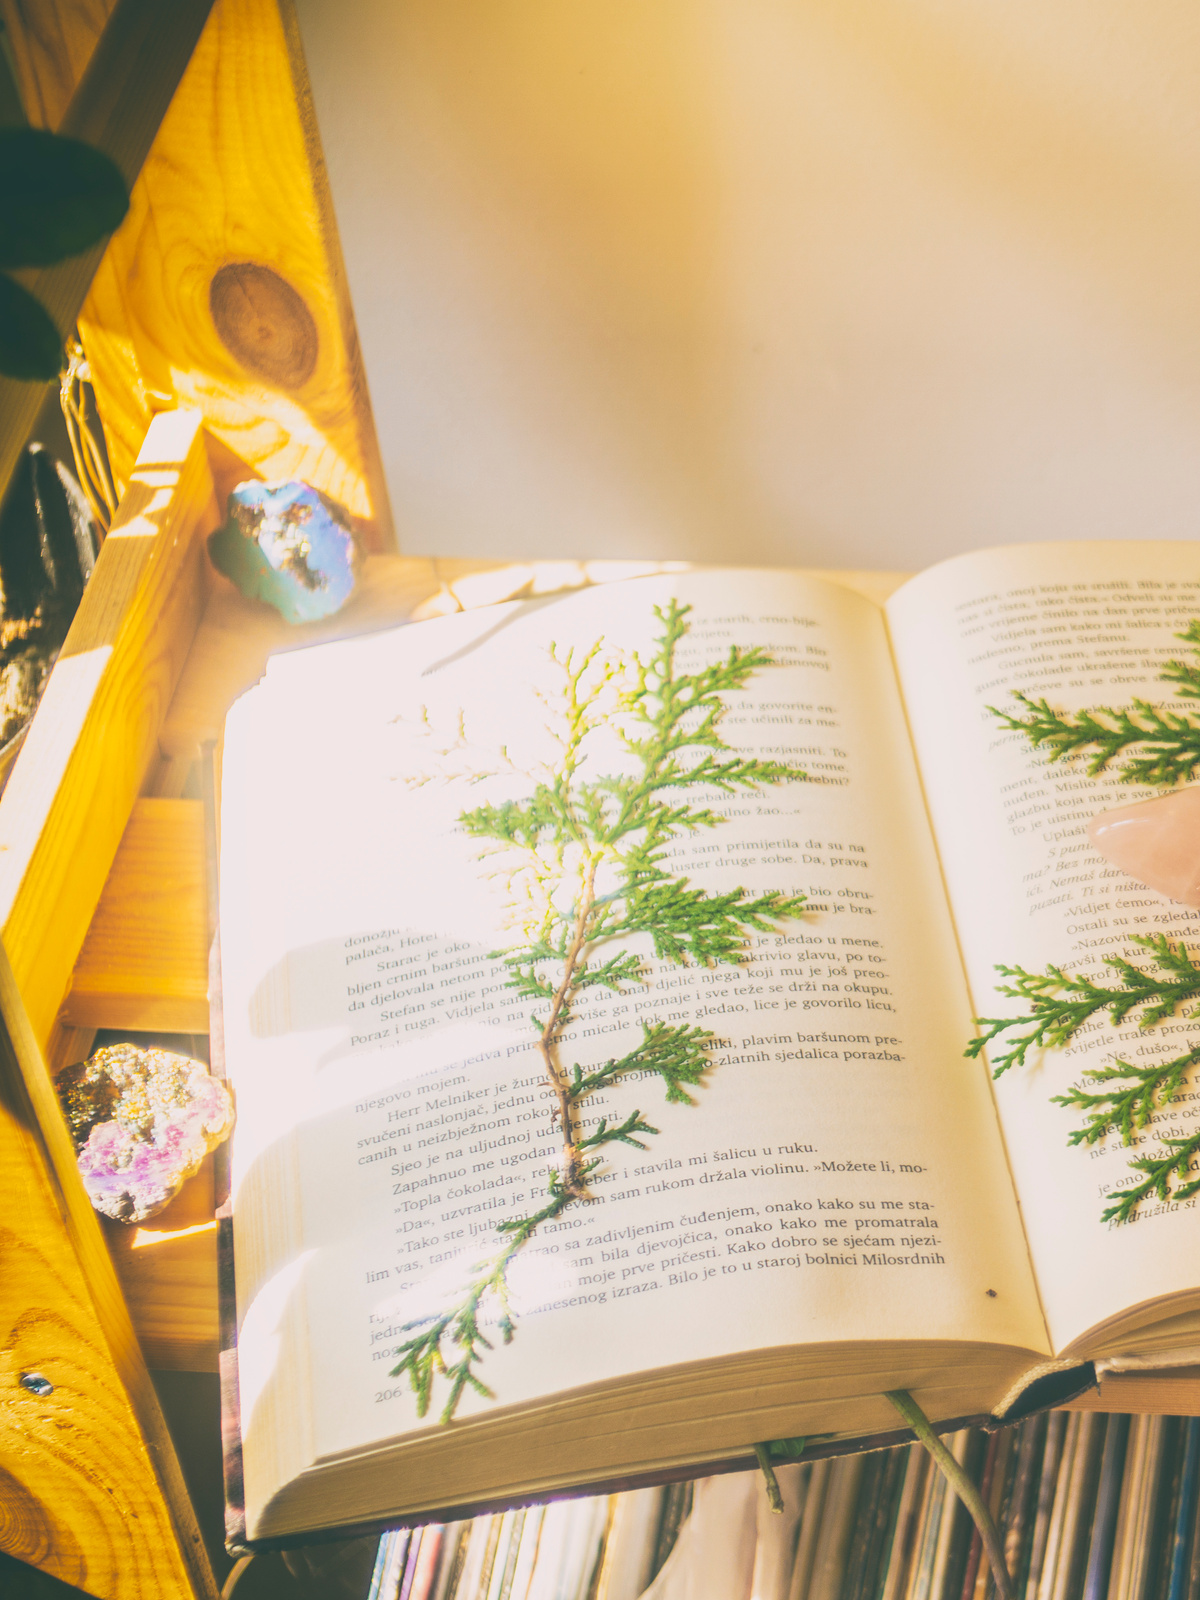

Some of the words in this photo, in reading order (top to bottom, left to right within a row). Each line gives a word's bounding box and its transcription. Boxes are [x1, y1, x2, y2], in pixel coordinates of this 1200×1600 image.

[686, 791, 735, 805] trebalo
[741, 788, 769, 799] reći.
[717, 807, 750, 817] silno
[692, 845, 720, 854] sam
[727, 839, 799, 853] primijetila
[805, 840, 822, 848] da
[671, 861, 710, 872] luster
[715, 858, 756, 867] druge
[761, 854, 796, 863] sobe.
[802, 854, 825, 865] Da,
[830, 858, 868, 868] prava
[1064, 903, 1111, 917] »Vidjet
[1116, 899, 1164, 908] ćemo«,
[1067, 918, 1108, 934] Ostali
[1113, 918, 1128, 926] su
[635, 993, 690, 1012] poznaje
[697, 990, 700, 1000] i
[706, 990, 728, 998] sve
[734, 984, 763, 995] teže
[789, 982, 816, 991] drži
[844, 982, 892, 996] okupu.
[583, 1020, 630, 1038] micale
[636, 1012, 662, 1027] dok
[668, 1011, 689, 1020] me
[695, 1003, 748, 1019] gledao,
[754, 1000, 778, 1010] lice
[784, 998, 796, 1010] je
[802, 998, 861, 1010] govorilo
[866, 999, 896, 1012] licu,
[742, 1034, 792, 1049] plavim
[797, 1032, 870, 1043] baršunom
[875, 1036, 902, 1046] pre-
[775, 1048, 839, 1062] sjedalica
[844, 1050, 905, 1061] porazba-
[387, 1106, 420, 1123] Herr
[426, 1086, 490, 1111] Melniker
[494, 1083, 508, 1097] je
[357, 1128, 411, 1148] svučeni
[416, 1105, 489, 1132] naslonjač,
[493, 1093, 535, 1114] jednu
[358, 1146, 397, 1165] canih
[402, 1143, 412, 1152] u
[418, 1116, 510, 1147] neizbježnom
[393, 1167, 467, 1195] Zapahnuo
[473, 1161, 494, 1172] me
[501, 1146, 556, 1167] ugodan
[634, 1158, 682, 1176] stavila
[689, 1153, 707, 1165] mi
[714, 1149, 756, 1161] šalicu
[778, 1142, 817, 1154] ruku.
[700, 1168, 746, 1184] držala
[751, 1164, 808, 1176] violinu.
[814, 1161, 876, 1171] »Možete
[880, 1161, 895, 1173] li,
[900, 1165, 927, 1173] mo-
[394, 1193, 441, 1214] »Topla
[447, 1174, 526, 1200] čokolada«,
[680, 1206, 760, 1226] čuđenjem,
[765, 1200, 812, 1212] onako
[817, 1198, 854, 1209] kako
[859, 1201, 875, 1209] su
[909, 1202, 934, 1210] sta-
[668, 1271, 698, 1285] Bilo
[702, 1267, 716, 1281] je
[722, 1265, 736, 1274] to
[742, 1262, 751, 1270] u
[758, 1254, 800, 1268] staroj
[805, 1253, 857, 1265] bolnici
[862, 1253, 945, 1265] Milosrdnih
[375, 1388, 402, 1403] 206
